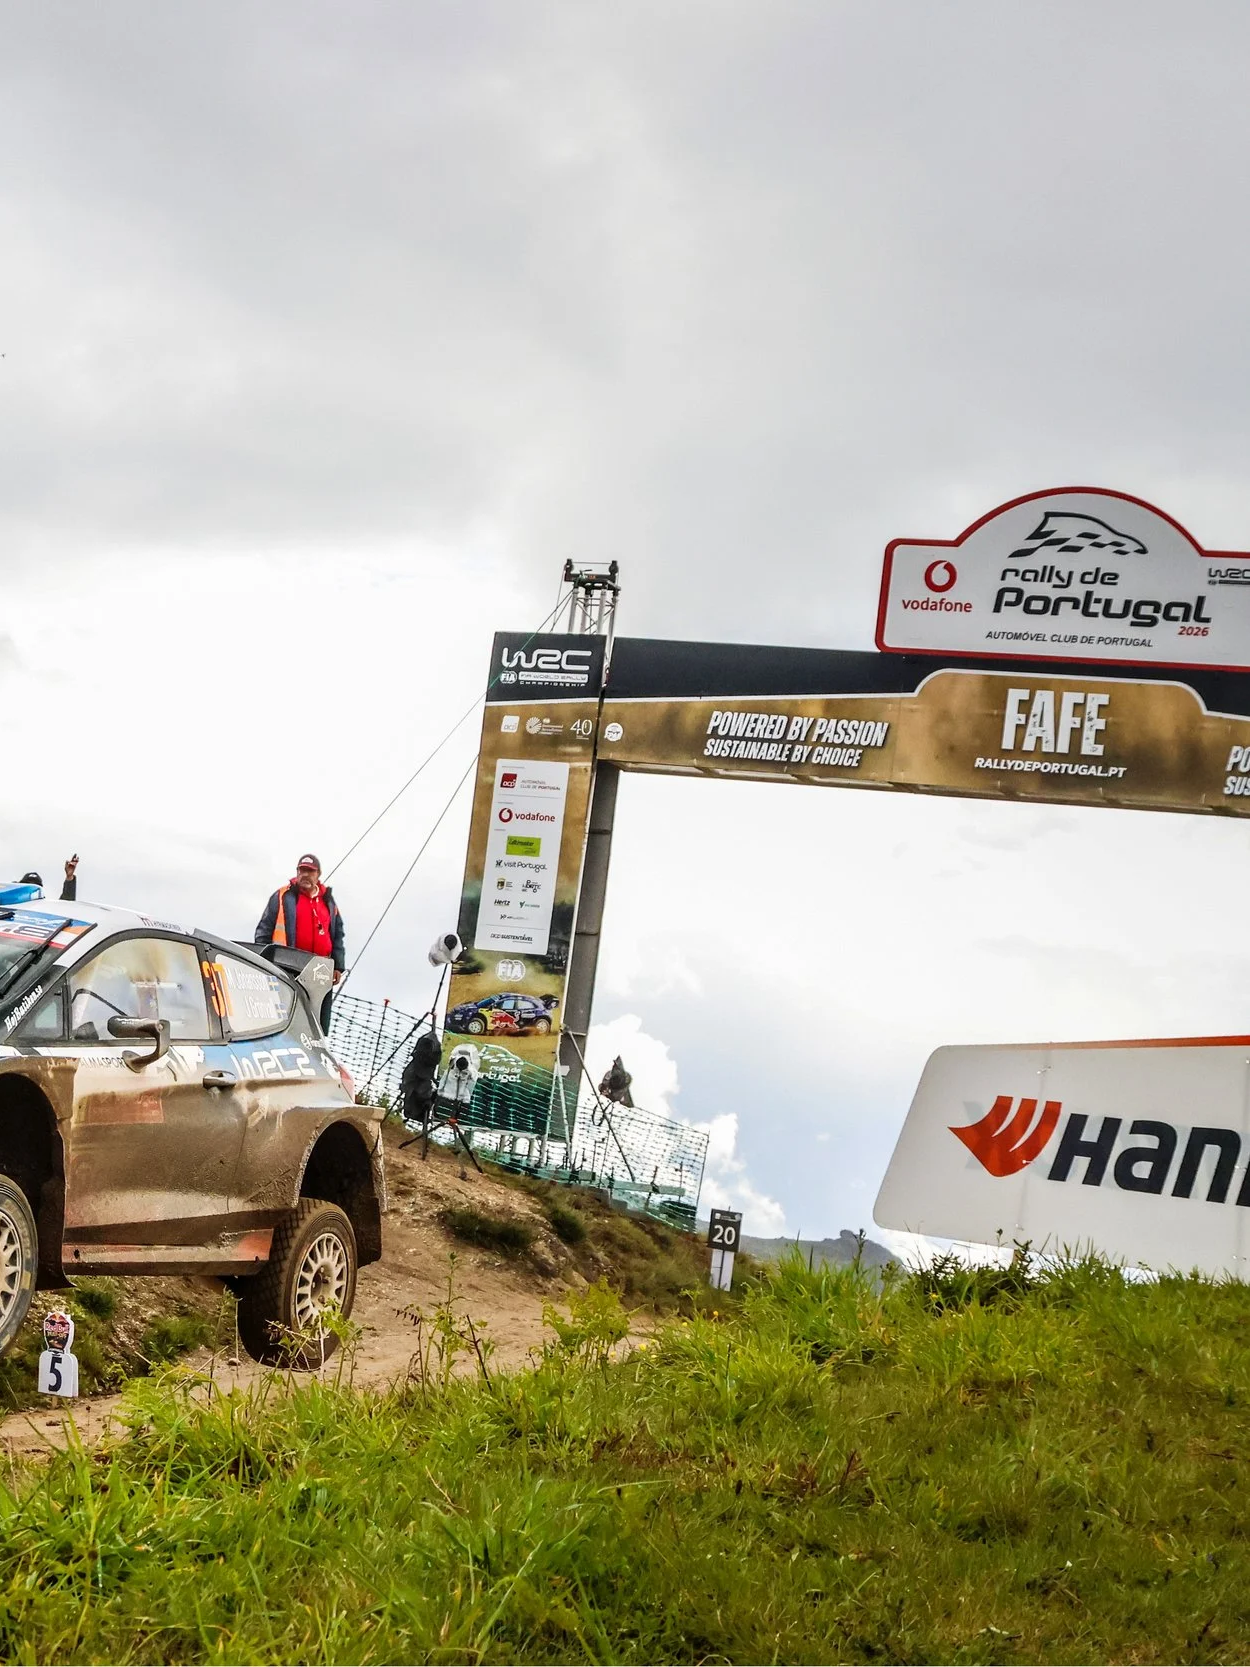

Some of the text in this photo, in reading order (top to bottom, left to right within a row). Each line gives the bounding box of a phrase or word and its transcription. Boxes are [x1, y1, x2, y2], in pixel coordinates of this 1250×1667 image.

[1000, 566, 1119, 588] rally de
[902, 598, 972, 613] vodafone
[993, 587, 1212, 627] Portugal
[985, 631, 1153, 647] AUTOMÓVEL CLUB DE PORTUGAL
[1177, 626, 1209, 637] 2026
[501, 647, 592, 671] WRC
[570, 718, 593, 735] 40
[707, 710, 890, 747] POWERED BY PASSION
[1001, 688, 1110, 756] FAFE
[703, 738, 863, 767] SUSTAINABLE BY CHOICE
[975, 757, 1127, 778] RALLYDEPORTUGAL.PT
[515, 812, 555, 822] vodafone
[517, 861, 547, 873] Portugal
[230, 1047, 316, 1080] WRC2
[1047, 1112, 1250, 1208] Han
[712, 1224, 736, 1245] 20
[48, 1356, 62, 1392] 5
